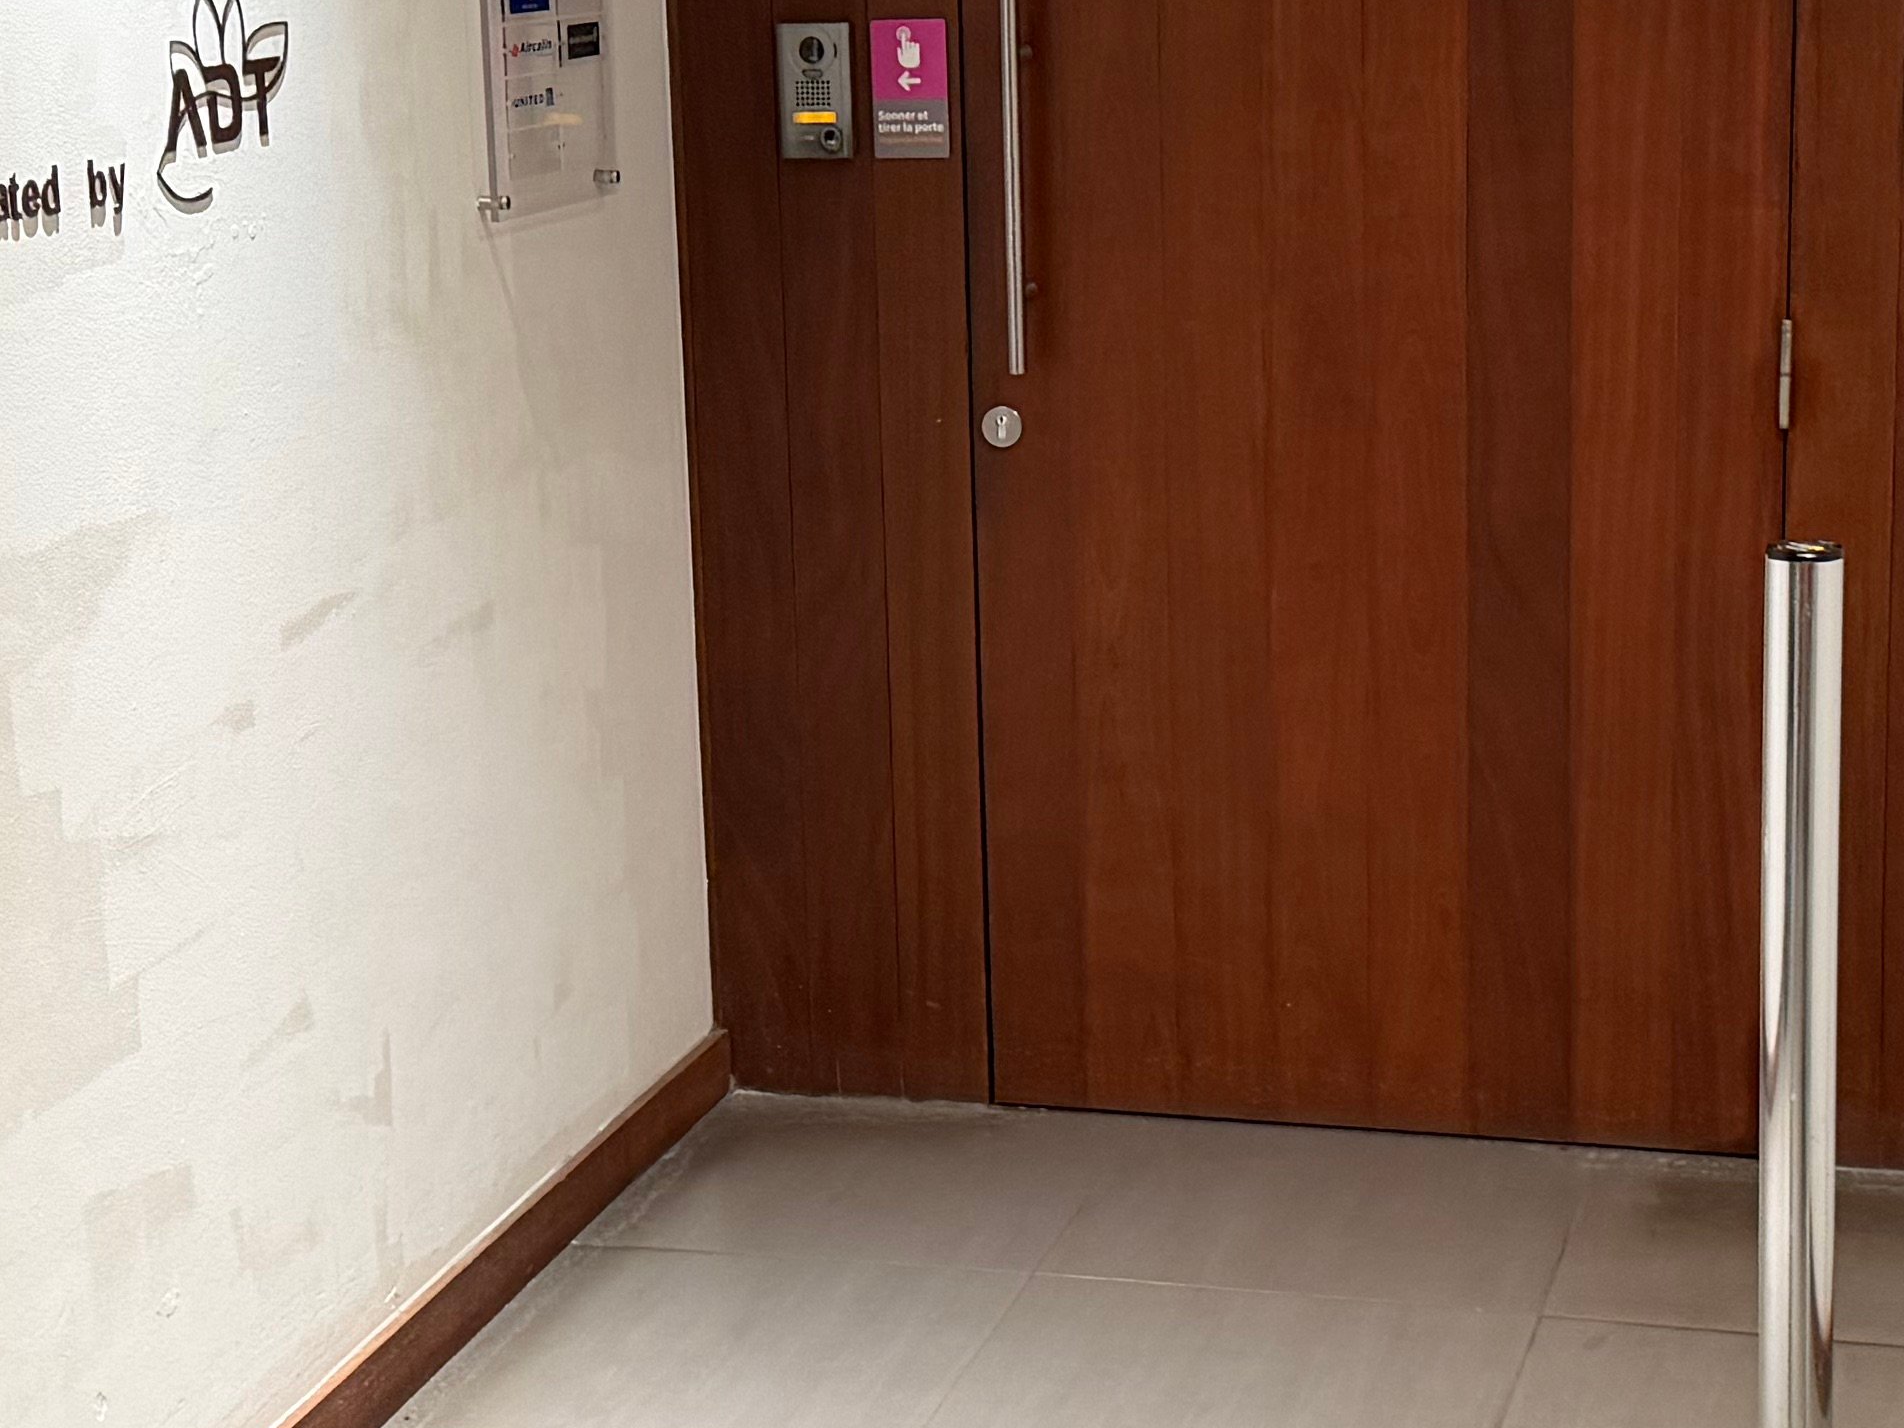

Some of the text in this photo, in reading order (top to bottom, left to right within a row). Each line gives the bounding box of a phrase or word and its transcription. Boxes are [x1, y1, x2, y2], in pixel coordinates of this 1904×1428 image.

[878, 110, 929, 122] Sonner et
[878, 121, 945, 135] tirer la porte
[86, 159, 126, 215] by
[166, 56, 282, 153] ADT
